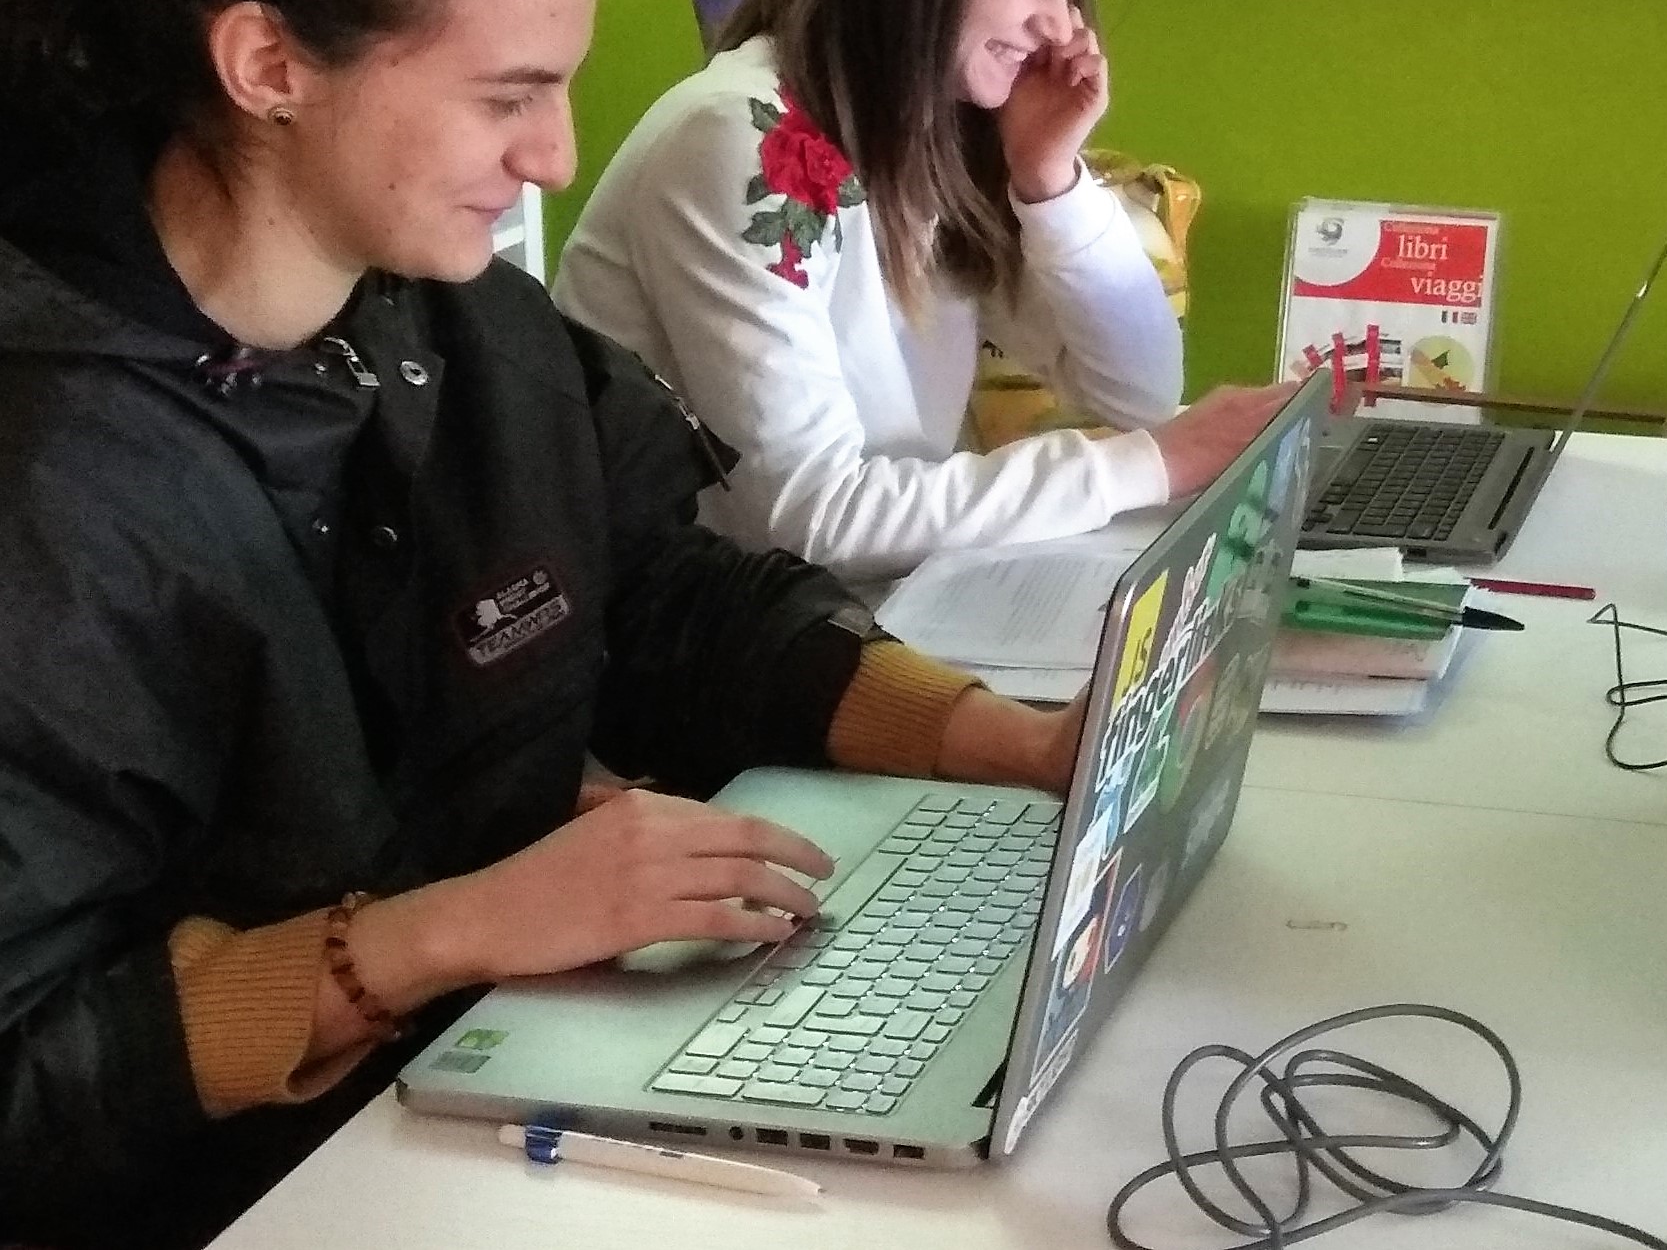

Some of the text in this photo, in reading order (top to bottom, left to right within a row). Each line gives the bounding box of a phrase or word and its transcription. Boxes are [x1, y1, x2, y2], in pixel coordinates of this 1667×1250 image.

[1398, 234, 1448, 261] libri
[1410, 270, 1483, 303] viaggi
[1120, 625, 1154, 698] JS
